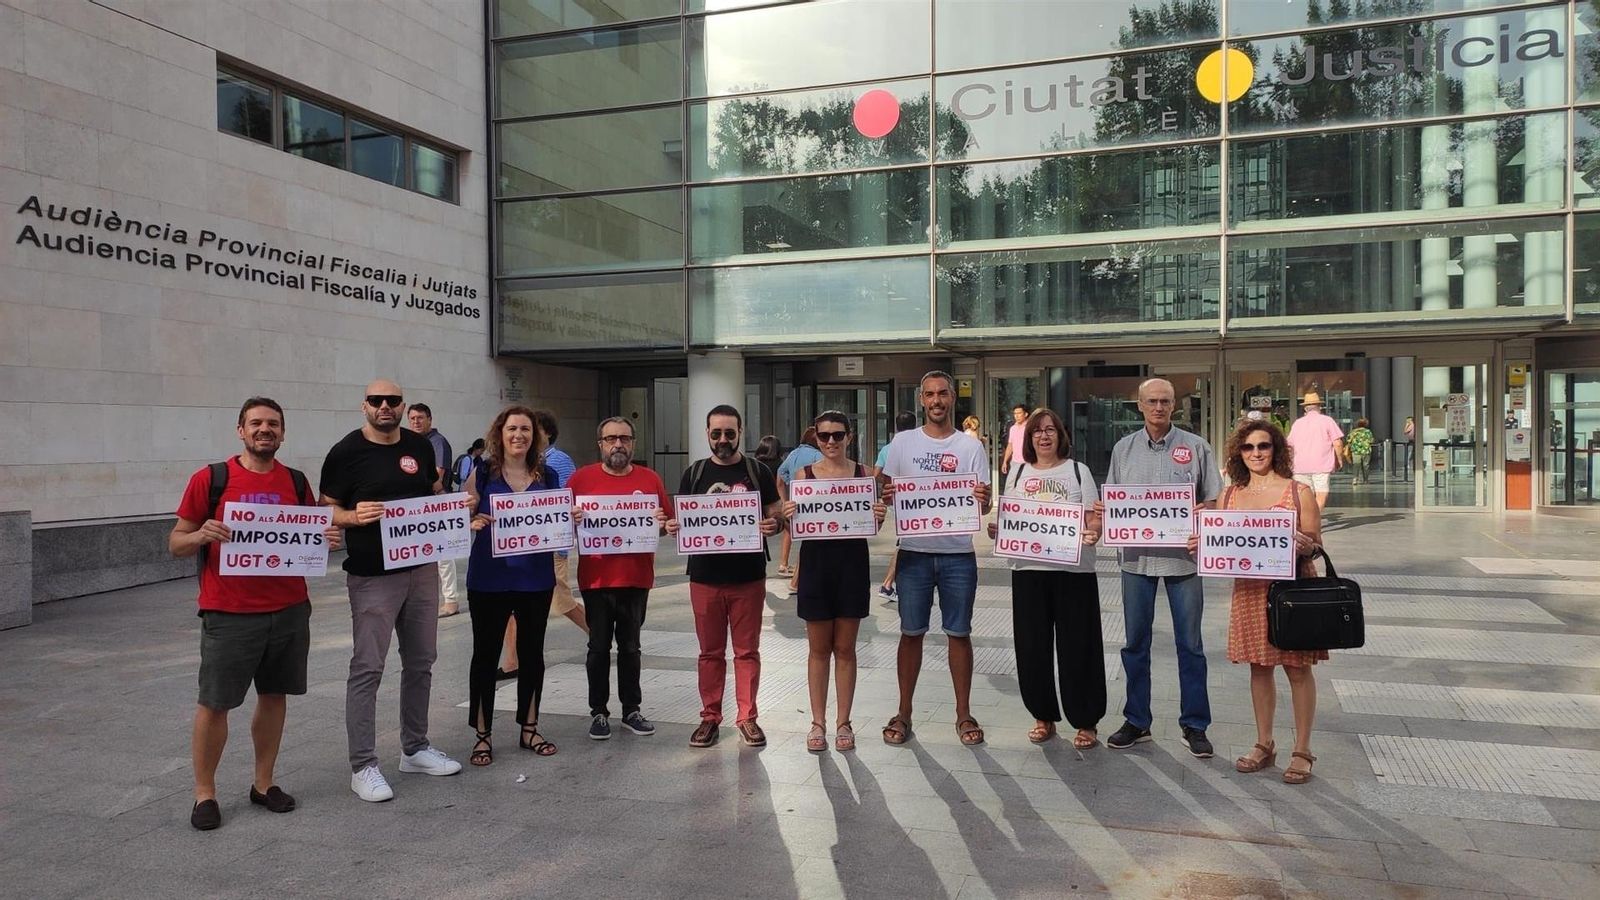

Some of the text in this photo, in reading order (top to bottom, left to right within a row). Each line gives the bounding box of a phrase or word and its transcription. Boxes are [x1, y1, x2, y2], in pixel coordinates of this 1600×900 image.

[951, 24, 1564, 121] Ciutat Justícia
[17, 195, 477, 300] Audiència Provincial Fiscalia i Jutjats
[15, 224, 481, 320] Audiencia Provincial Fiscalía y Juzgados
[1173, 447, 1190, 457] UGT
[913, 457, 941, 466] NORTH
[942, 456, 956, 466] UGT
[920, 464, 941, 472] FACE
[794, 486, 812, 496] NO
[830, 483, 872, 495] ÀMBITS
[897, 483, 916, 492] NO
[933, 479, 975, 490] ÀMBITS
[1107, 491, 1126, 500] NO
[1144, 489, 1190, 500] ÀMBITS
[386, 507, 405, 518] NO
[423, 500, 465, 514] ÀMBITS
[496, 500, 514, 510] NO
[531, 496, 570, 507] ÀMBITS
[581, 502, 599, 510] NO
[615, 499, 655, 510] ÀMBITS
[680, 501, 698, 510] NO
[715, 497, 757, 509] ÀMBITS
[797, 500, 870, 514] IMPOSATS
[901, 496, 974, 510] IMPOSATS
[231, 510, 255, 521] NO
[276, 510, 327, 525] ÀMBITS
[1002, 503, 1020, 512] NO
[1037, 504, 1080, 519] ÀMBITS
[1110, 507, 1189, 519] IMPOSATS
[498, 512, 569, 528] IMPOSATS
[583, 516, 653, 528] IMPOSATS
[683, 515, 755, 528] IMPOSATS
[900, 518, 929, 531] UGT
[1204, 517, 1224, 527] NO
[1242, 515, 1290, 528] ÀMBITS
[389, 518, 464, 538] IMPOSATS
[795, 521, 825, 534] UGT
[1003, 519, 1076, 537] IMPOSATS
[1108, 528, 1138, 540] UGT
[231, 530, 323, 545] IMPOSATS
[497, 536, 526, 549] UGT
[583, 537, 609, 548] UGT
[682, 536, 711, 548] UGT
[1206, 535, 1288, 549] IMPOSATS
[1000, 539, 1028, 552] UGT
[389, 545, 419, 561] UGT
[226, 554, 263, 568] UGT
[1204, 557, 1236, 570] UGT
